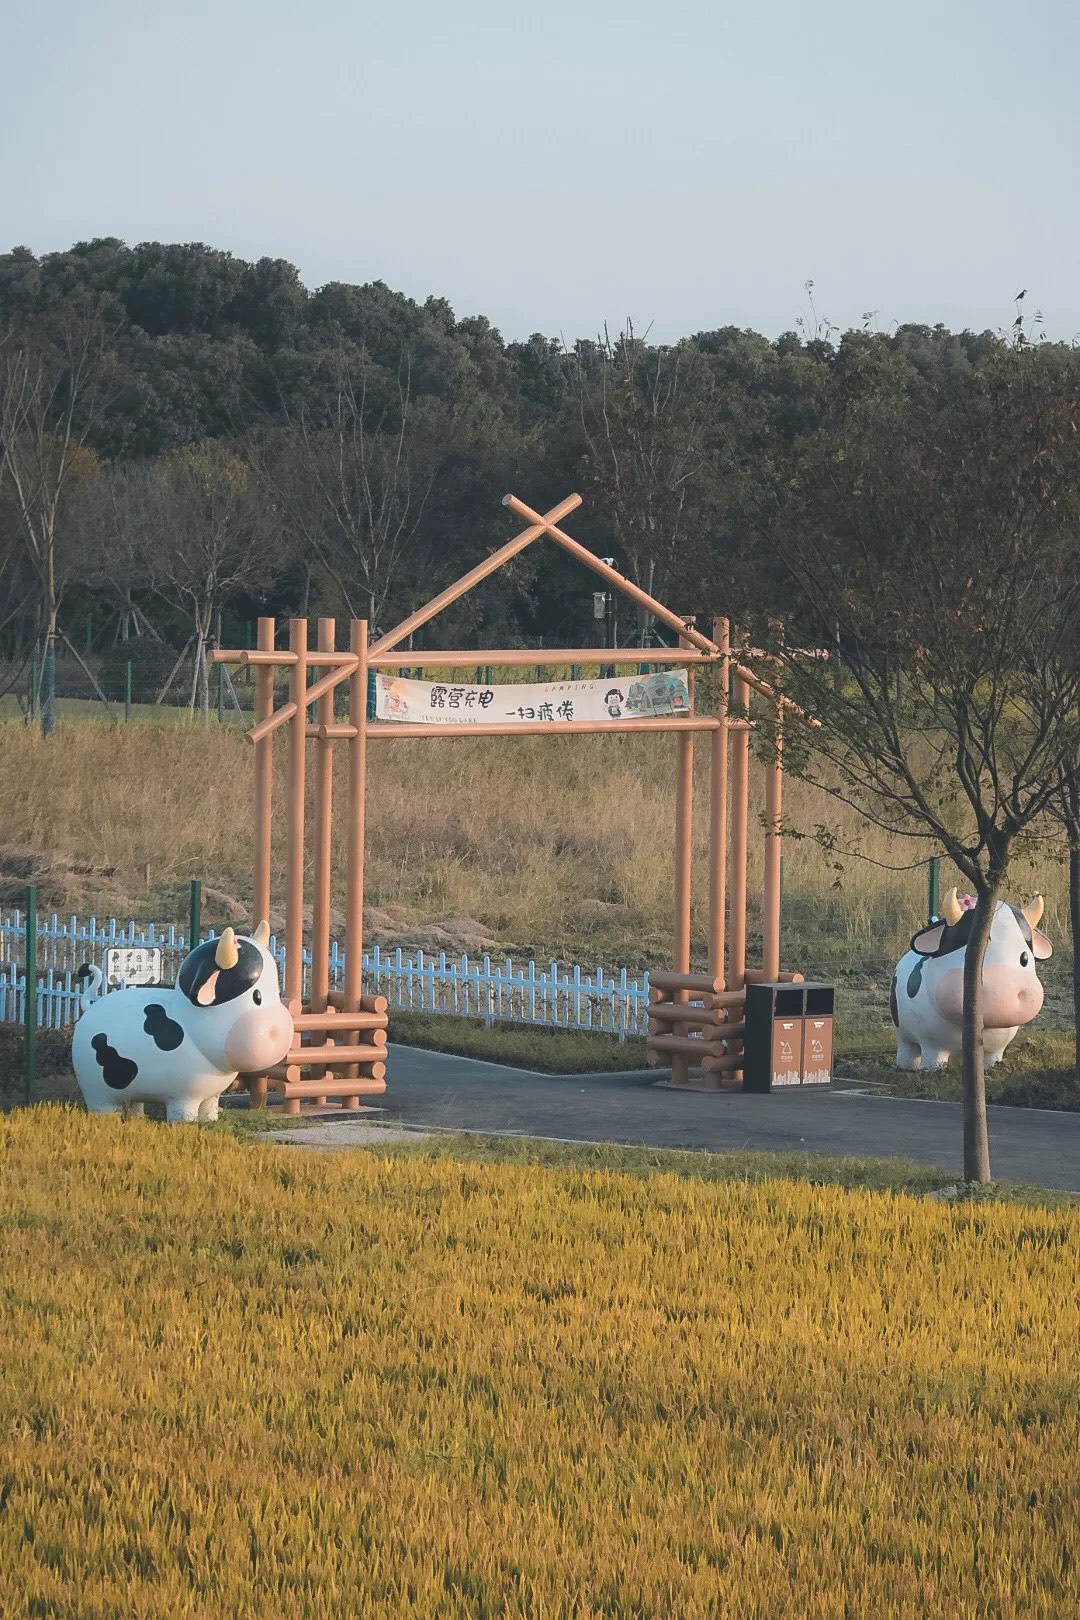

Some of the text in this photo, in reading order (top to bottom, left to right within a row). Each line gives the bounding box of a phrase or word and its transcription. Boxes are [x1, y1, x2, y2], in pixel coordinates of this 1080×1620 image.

[430, 685, 494, 709] 露营充电
[544, 683, 595, 692] CAMPING
[505, 700, 574, 722] 一扫疲倦
